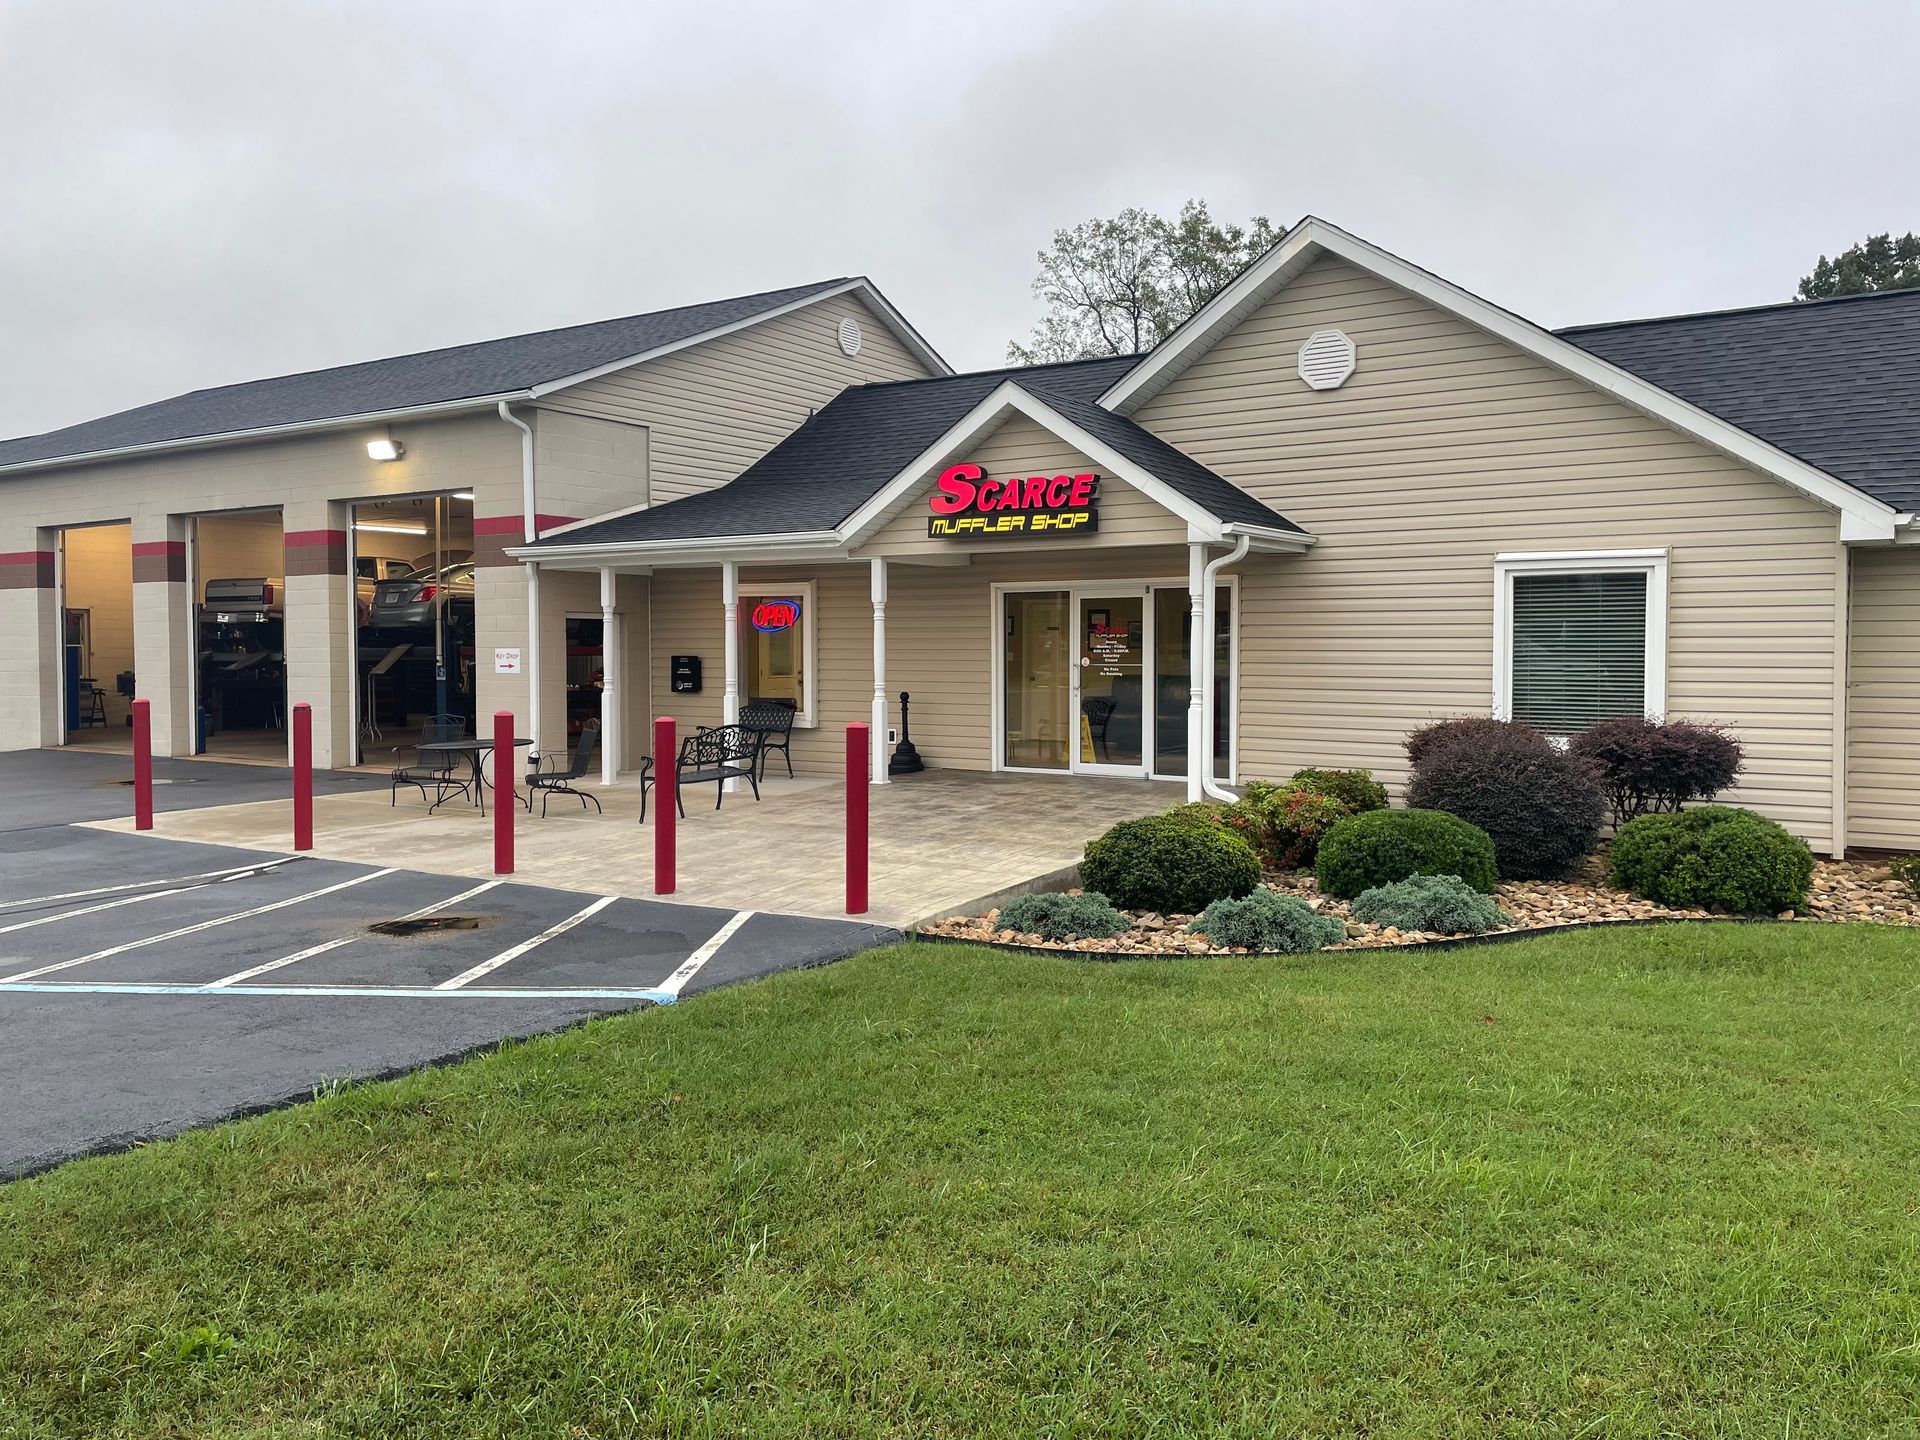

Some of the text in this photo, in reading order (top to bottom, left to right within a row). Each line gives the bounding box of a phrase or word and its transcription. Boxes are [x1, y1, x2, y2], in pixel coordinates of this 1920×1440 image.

[929, 463, 1096, 514] SCARCE
[931, 512, 1090, 535] MUFFLER SHOP
[752, 605, 795, 627] OPEN
